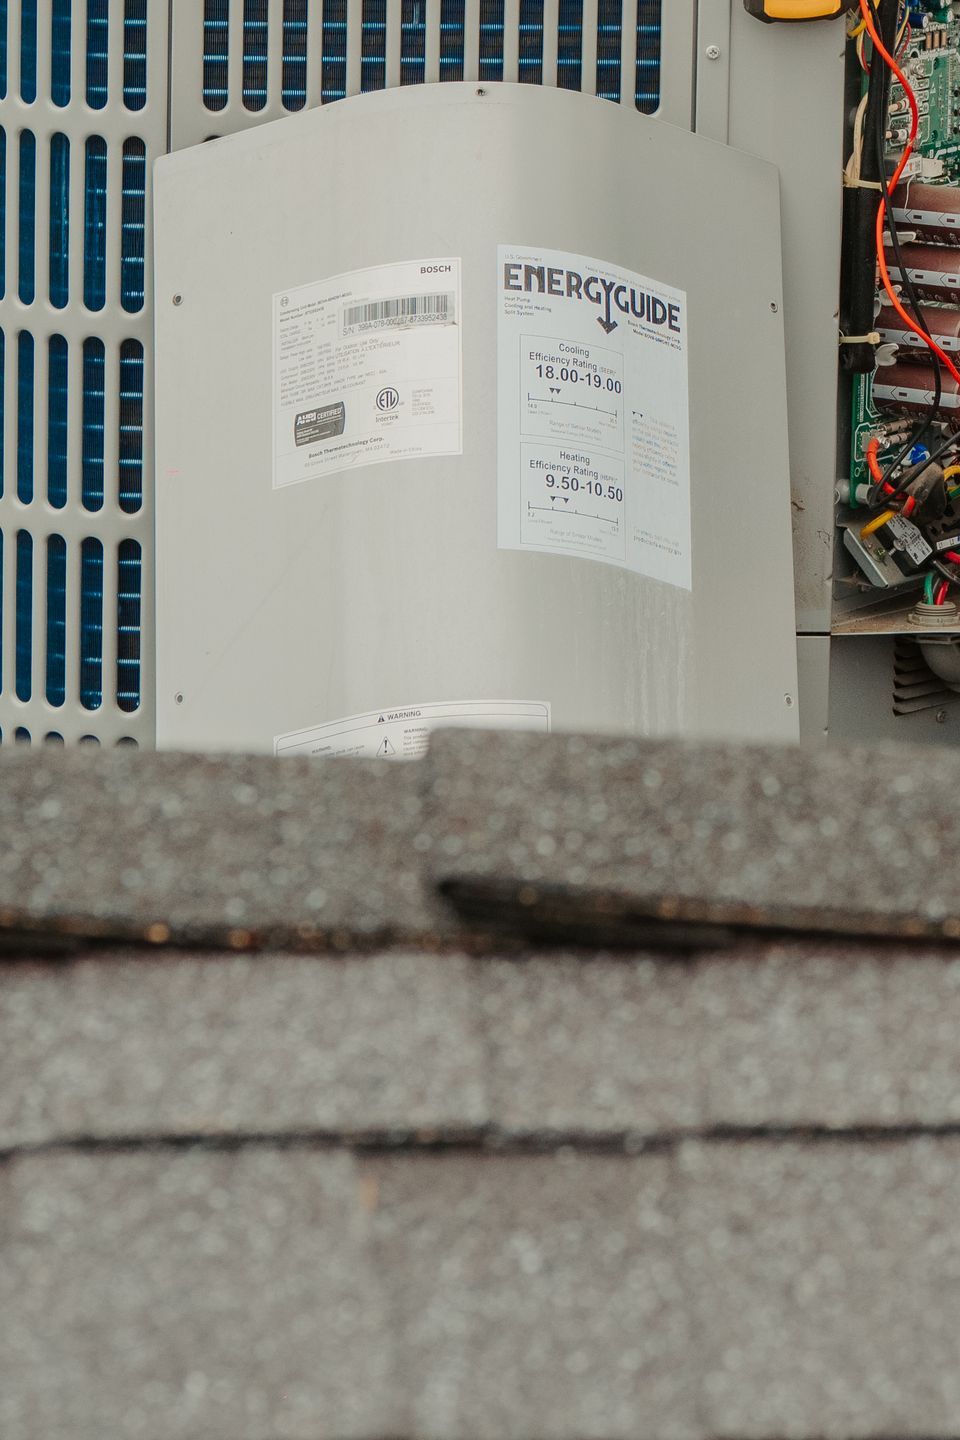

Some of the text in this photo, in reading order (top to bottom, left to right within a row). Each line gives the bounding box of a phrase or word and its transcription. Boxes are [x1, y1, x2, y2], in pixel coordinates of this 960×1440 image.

[420, 265, 451, 274] BOSCH
[504, 263, 681, 335] ENERGYGUIDE
[559, 343, 590, 358] Cooling
[529, 352, 570, 366] Efficiency
[572, 358, 598, 372] Rating
[536, 364, 622, 394] 18.00-19.00
[308, 450, 323, 459] Bosch
[323, 439, 369, 455] Thermotechnology
[559, 451, 590, 466] Heating
[529, 459, 571, 474] Efficiency
[573, 466, 599, 480] Rating
[545, 474, 623, 502] 9.50-10.50
[387, 710, 421, 721] WARNING
